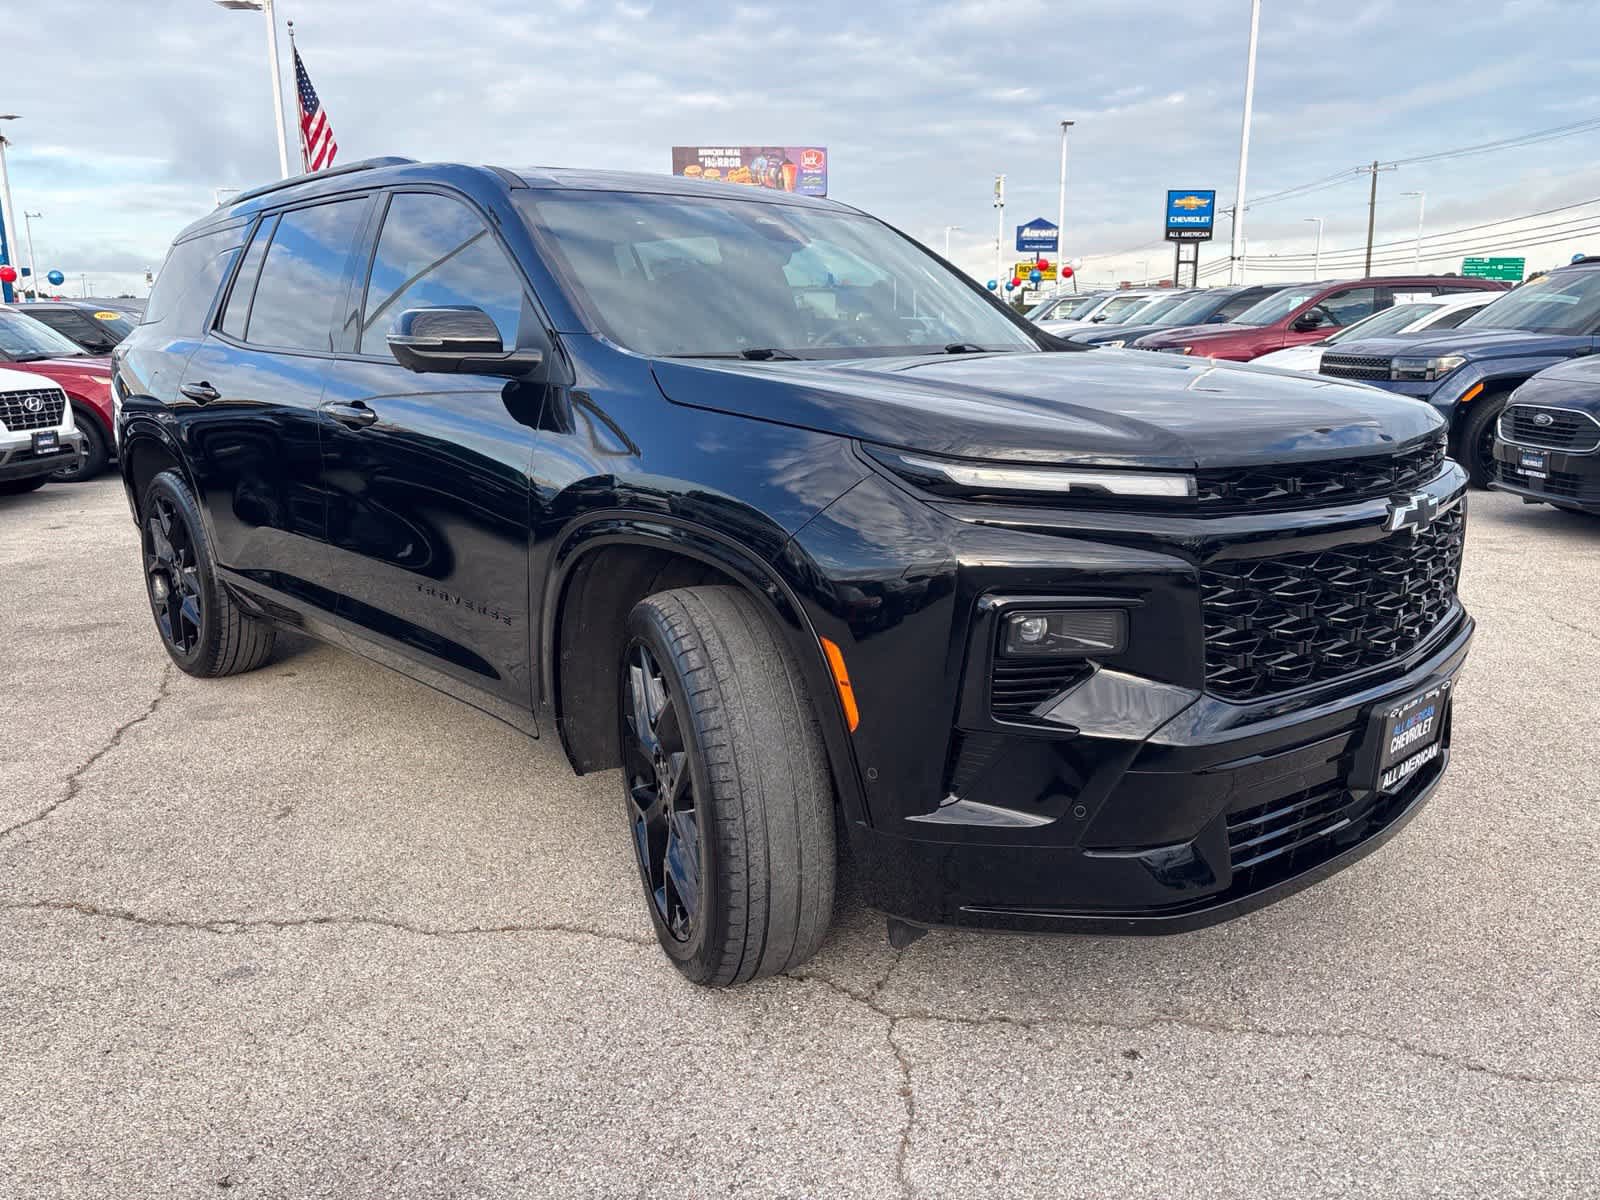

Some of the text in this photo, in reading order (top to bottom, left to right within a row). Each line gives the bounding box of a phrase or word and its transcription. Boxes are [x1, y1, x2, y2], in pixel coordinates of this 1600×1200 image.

[1390, 716, 1434, 754] CHEVROLET
[1382, 743, 1439, 790] ALL AMERICAN
